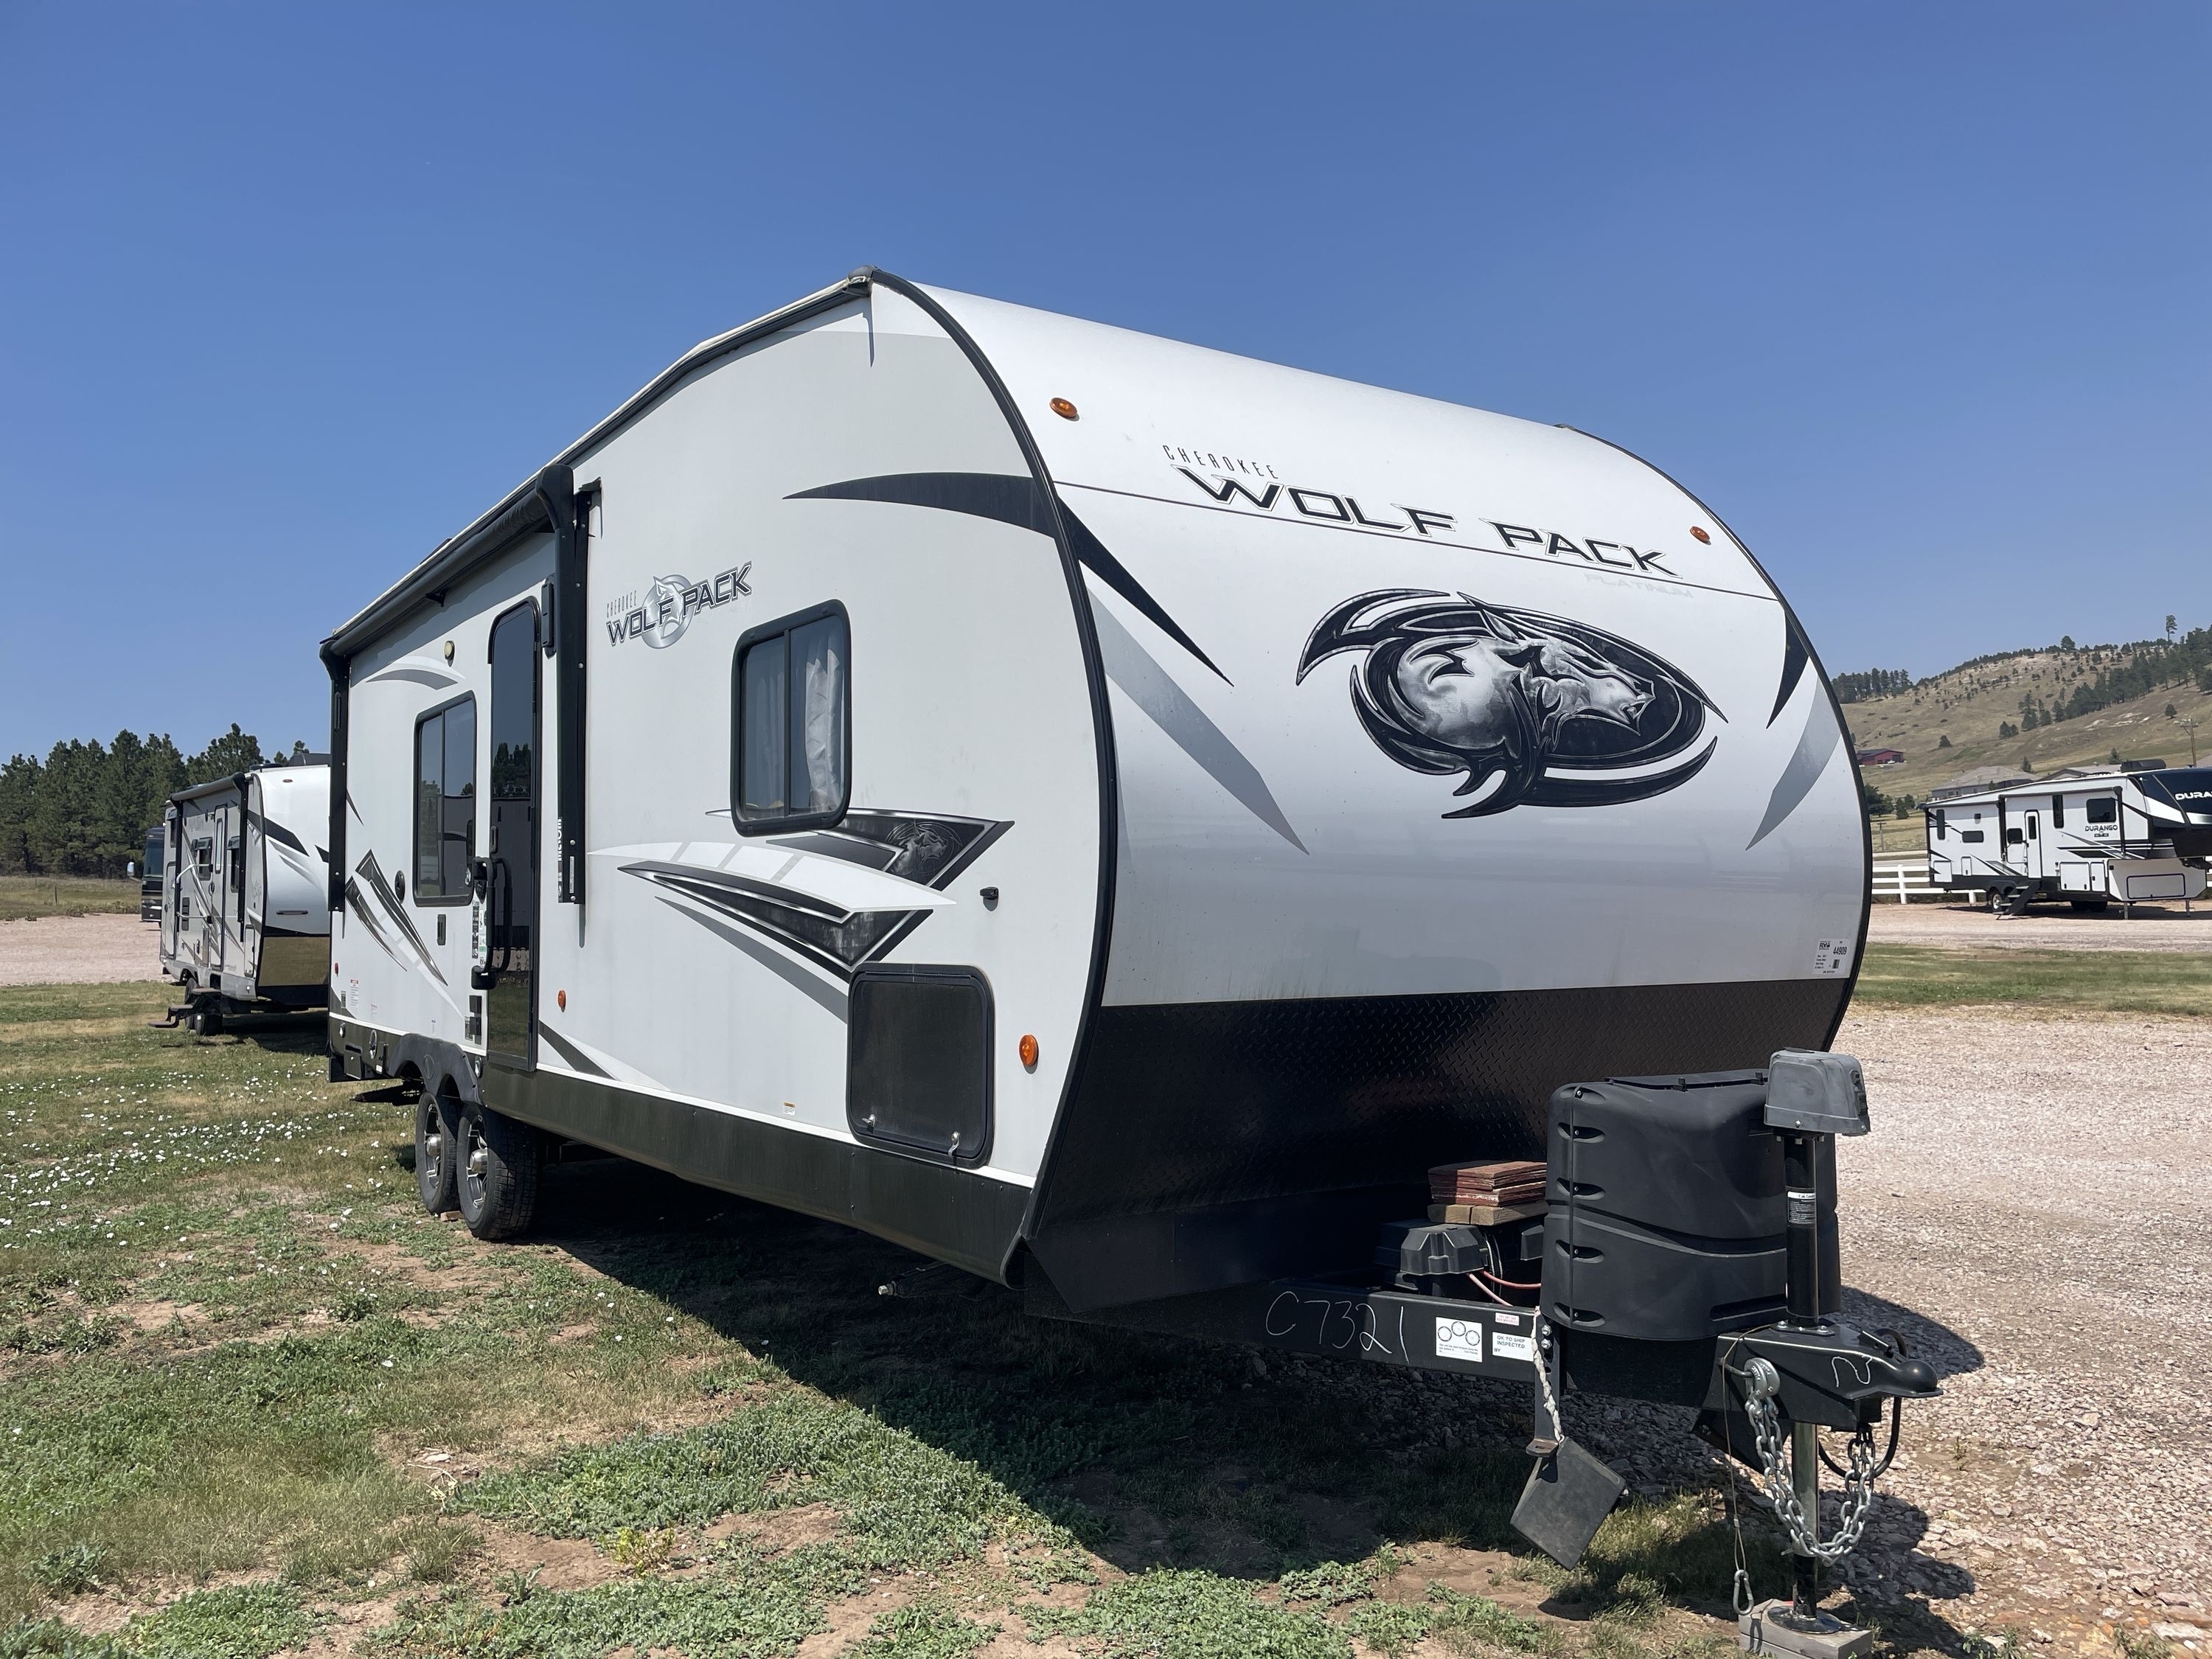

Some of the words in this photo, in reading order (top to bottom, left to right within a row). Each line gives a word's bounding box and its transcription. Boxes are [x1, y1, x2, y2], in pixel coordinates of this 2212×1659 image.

[1162, 444, 1279, 479] CHEROKEE
[1169, 463, 1458, 537] WOLF
[1481, 517, 1682, 579] PACK
[606, 596, 674, 647] WOLF
[681, 560, 752, 618] PACK
[2174, 791, 2212, 801] DURA
[1497, 1340, 1526, 1349] INSPECTED
